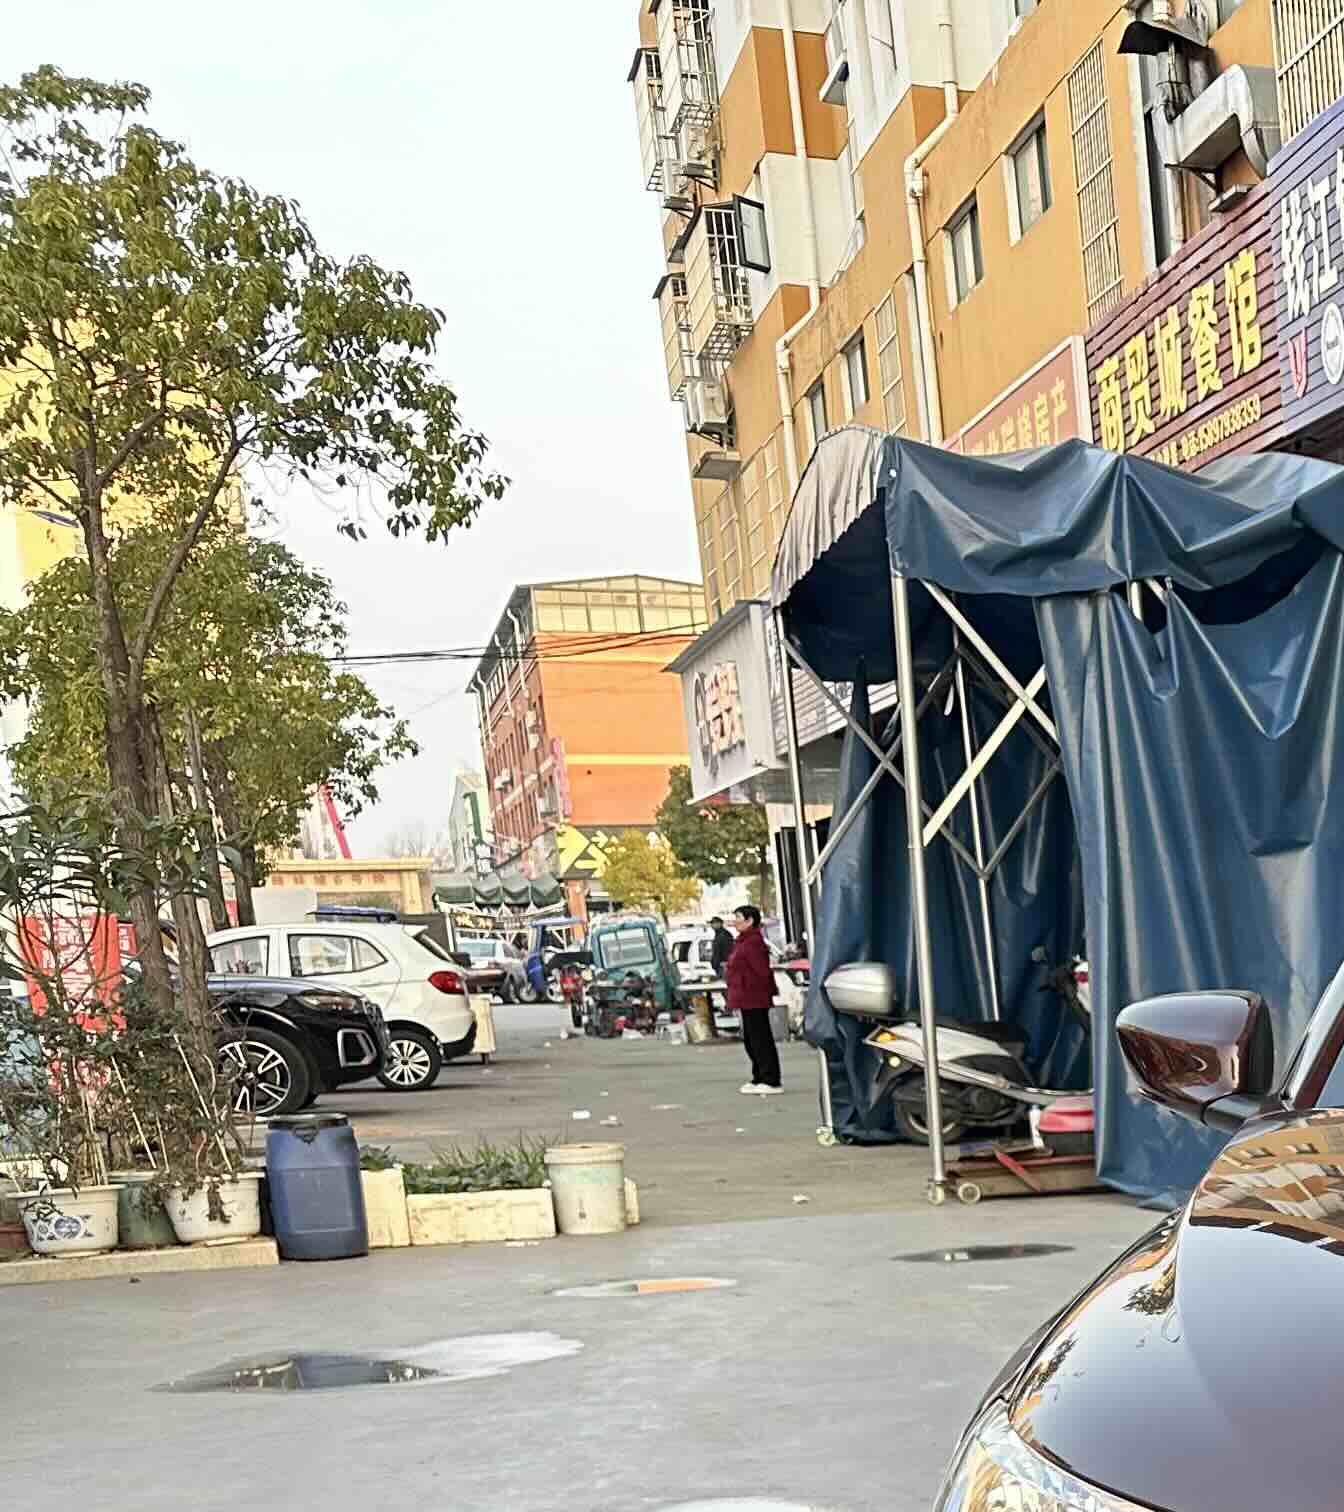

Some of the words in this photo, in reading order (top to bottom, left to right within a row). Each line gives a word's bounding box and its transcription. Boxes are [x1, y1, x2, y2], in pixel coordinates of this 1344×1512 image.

[1096, 248, 1263, 454] 商贸城餐馆
